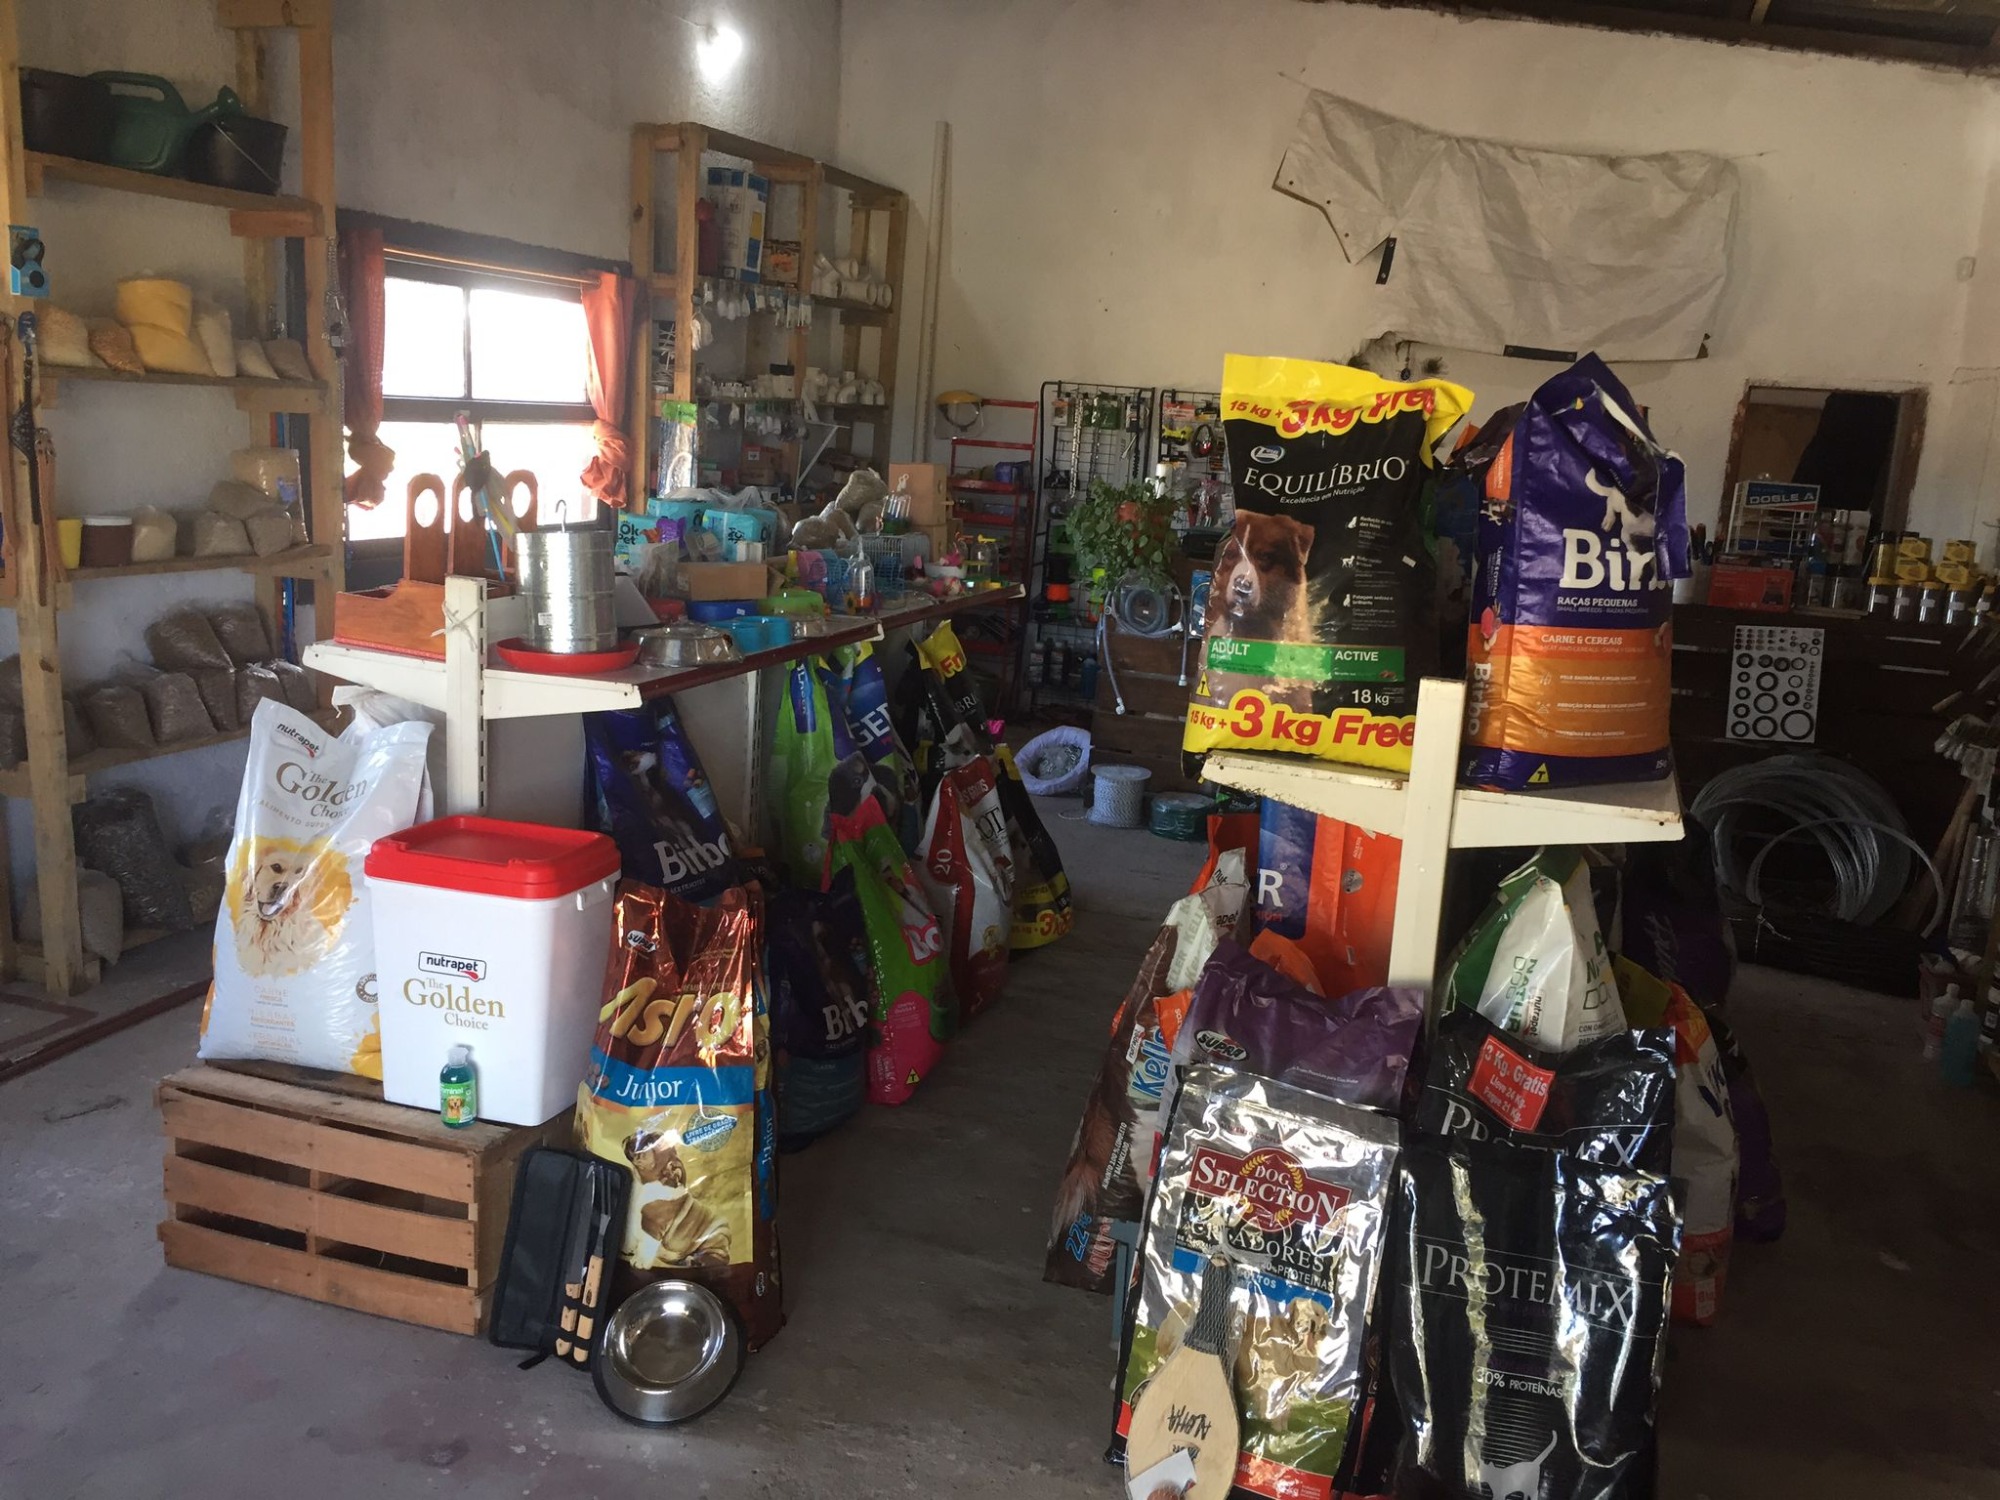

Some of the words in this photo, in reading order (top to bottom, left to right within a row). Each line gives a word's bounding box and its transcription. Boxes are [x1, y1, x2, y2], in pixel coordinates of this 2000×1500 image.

[1230, 400, 1245, 411] 15
[1249, 404, 1270, 420] kg
[1243, 456, 1406, 497] EQUILÍBRIO
[1557, 596, 1591, 607] RAÇAS
[1592, 598, 1638, 608] PEQUENAS
[1211, 640, 1251, 656] ADULT
[1334, 650, 1379, 662] ACTIVE
[1541, 634, 1576, 645] CARNE
[1584, 635, 1623, 646] CEREAIS
[1351, 688, 1372, 704] 18
[1374, 692, 1390, 706] kg
[1467, 662, 1492, 736] Birbo
[1229, 695, 1266, 738] 3
[1270, 710, 1322, 747] kg
[276, 723, 320, 753] nutrapet
[933, 848, 953, 876] 20
[426, 956, 479, 972] nutrapet
[426, 976, 444, 990] The
[403, 978, 506, 1018] Golden
[443, 1012, 490, 1031] Choice
[1530, 995, 1542, 1038] nutrapet
[1198, 1033, 1244, 1058] SUPRA
[1484, 1044, 1495, 1062] 3
[1493, 1050, 1511, 1078] Kg.
[1513, 1066, 1549, 1096] Gratis
[1506, 1088, 1516, 1100] 24
[685, 1127, 703, 1139] LIVRE
[703, 1124, 712, 1132] DE
[1254, 1165, 1291, 1186] DOG
[1194, 1156, 1340, 1221] SELECTION
[1421, 1243, 1634, 1328] PROTEMIX
[1476, 1367, 1506, 1388] 30%
[1508, 1378, 1564, 1399] PROTEÍNAS
